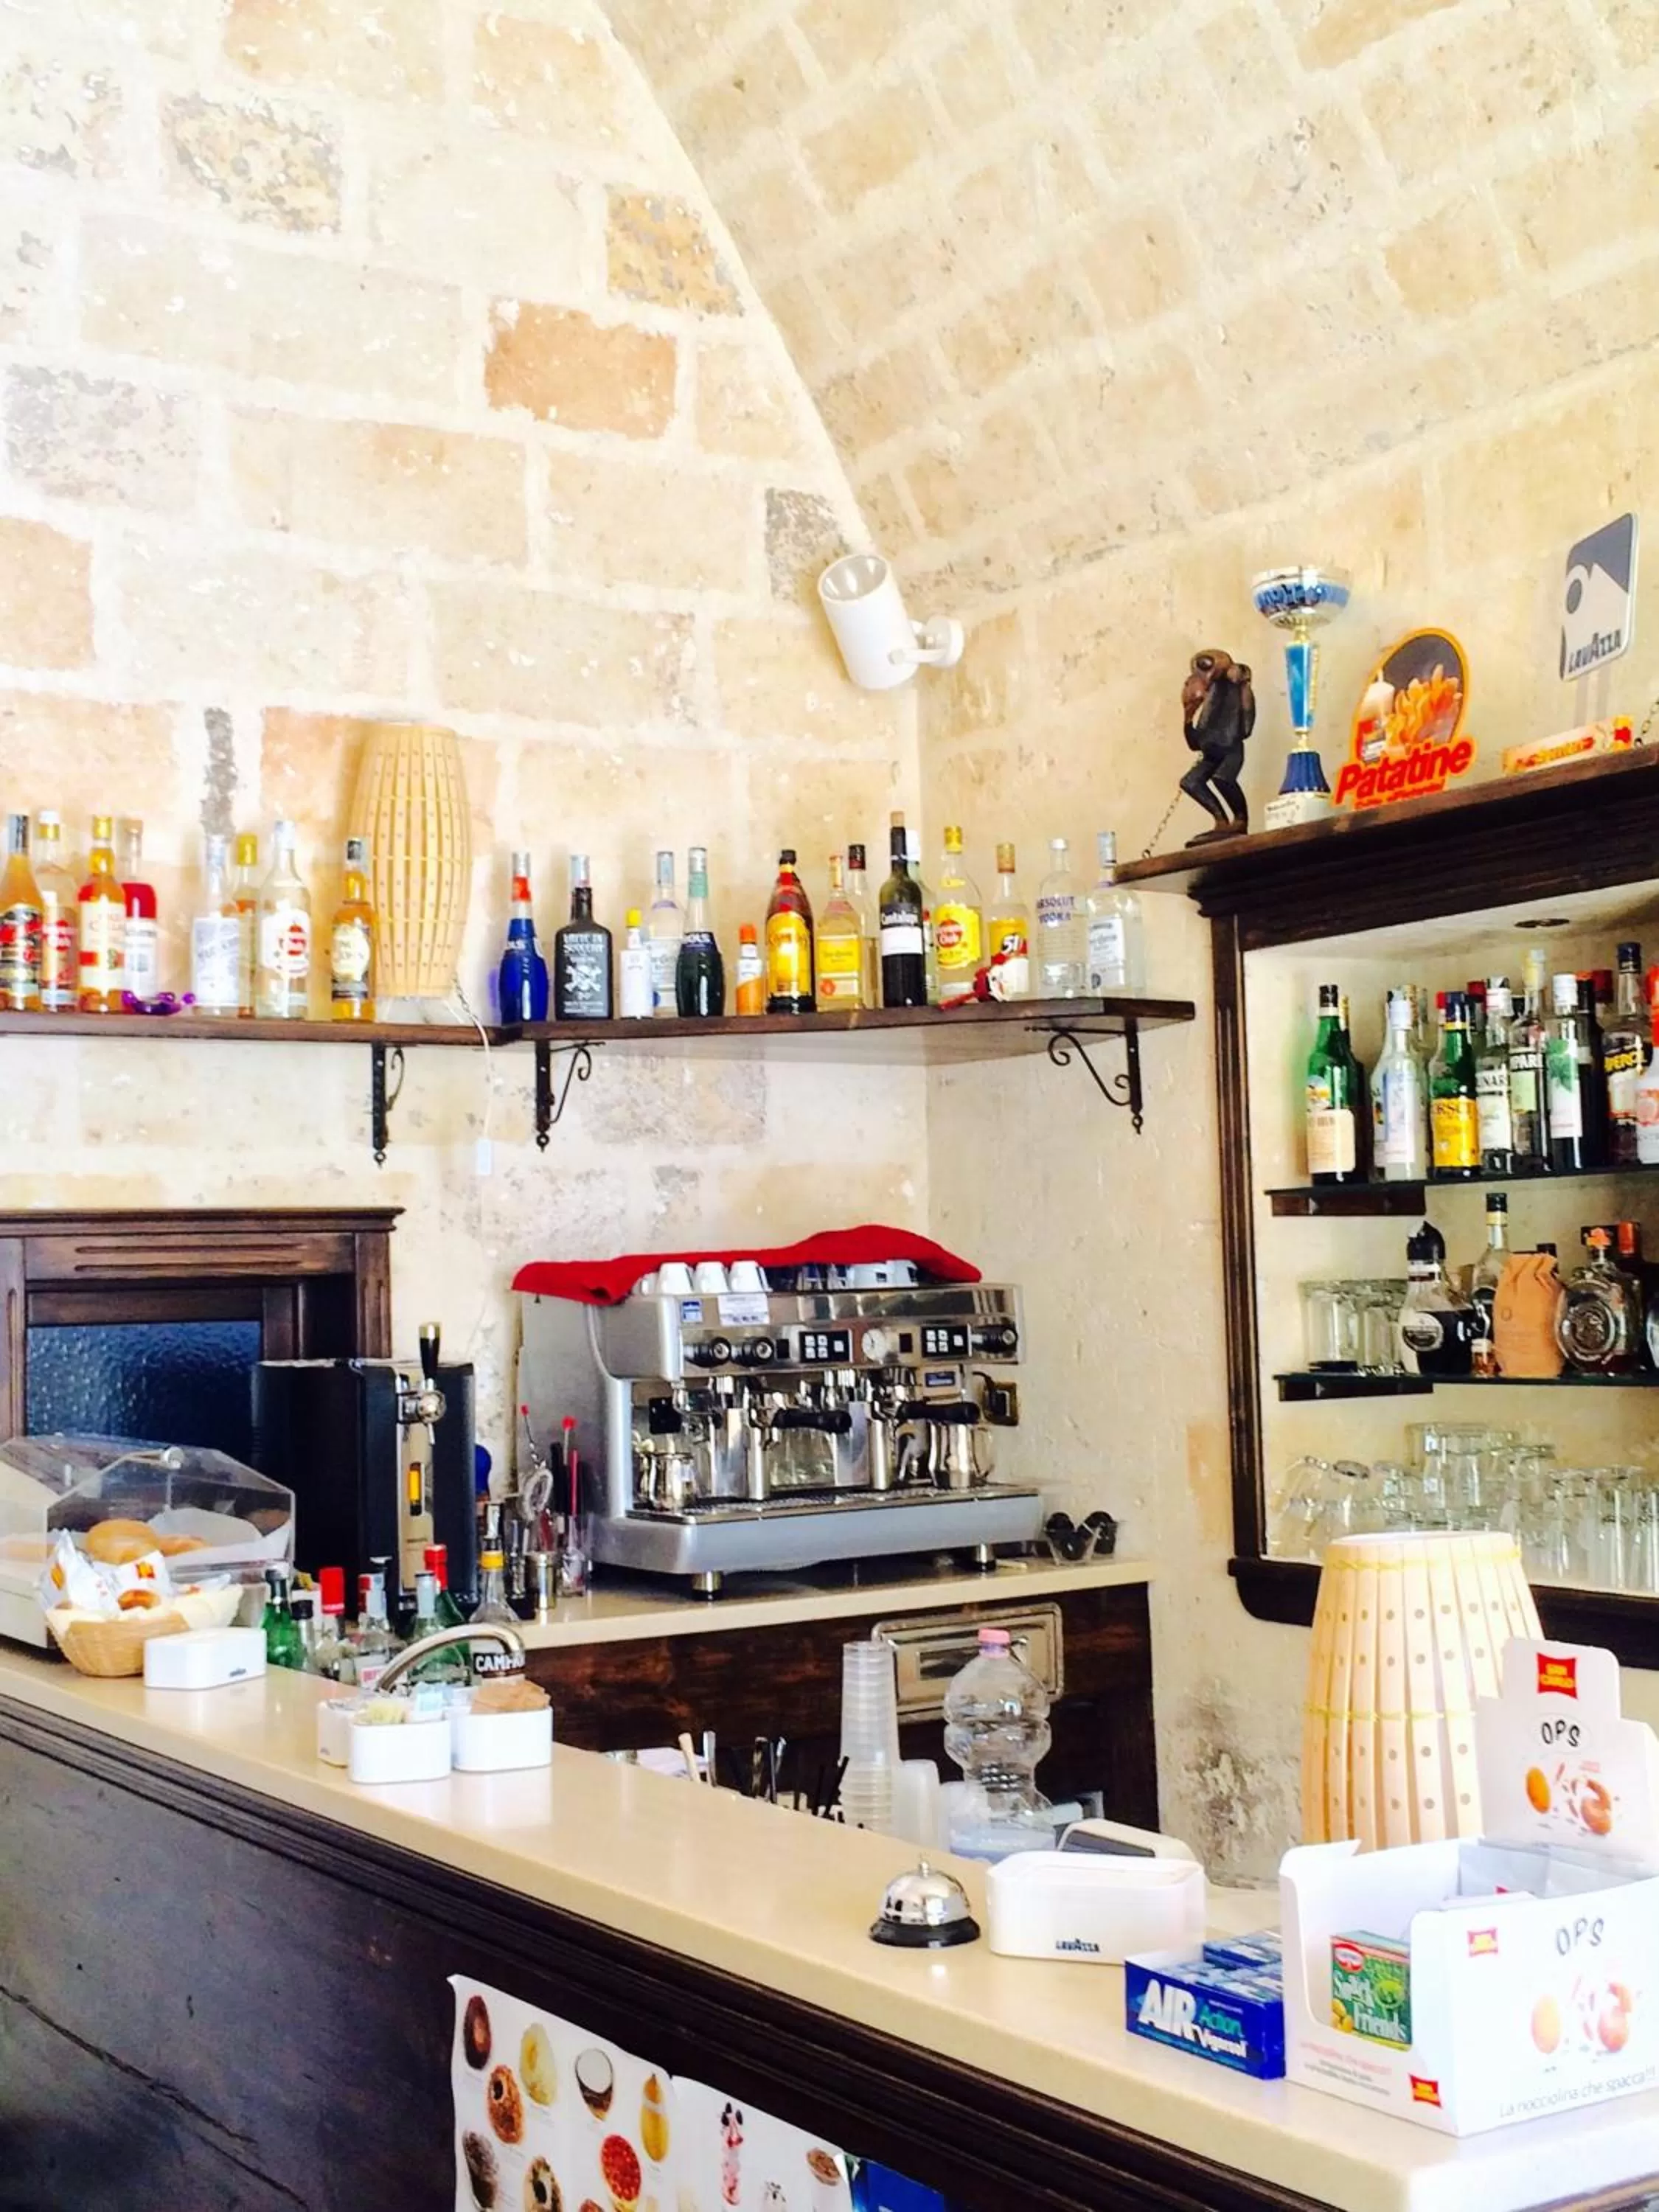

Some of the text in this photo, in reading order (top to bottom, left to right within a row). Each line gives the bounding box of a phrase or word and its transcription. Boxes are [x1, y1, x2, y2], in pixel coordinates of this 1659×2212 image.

[1335, 740, 1472, 804] Patatine
[1541, 1719, 1580, 1748] OPS
[1556, 1916, 1604, 1956] OPS
[1138, 1978, 1197, 2043] AIR
[1499, 2101, 1515, 2118] La
